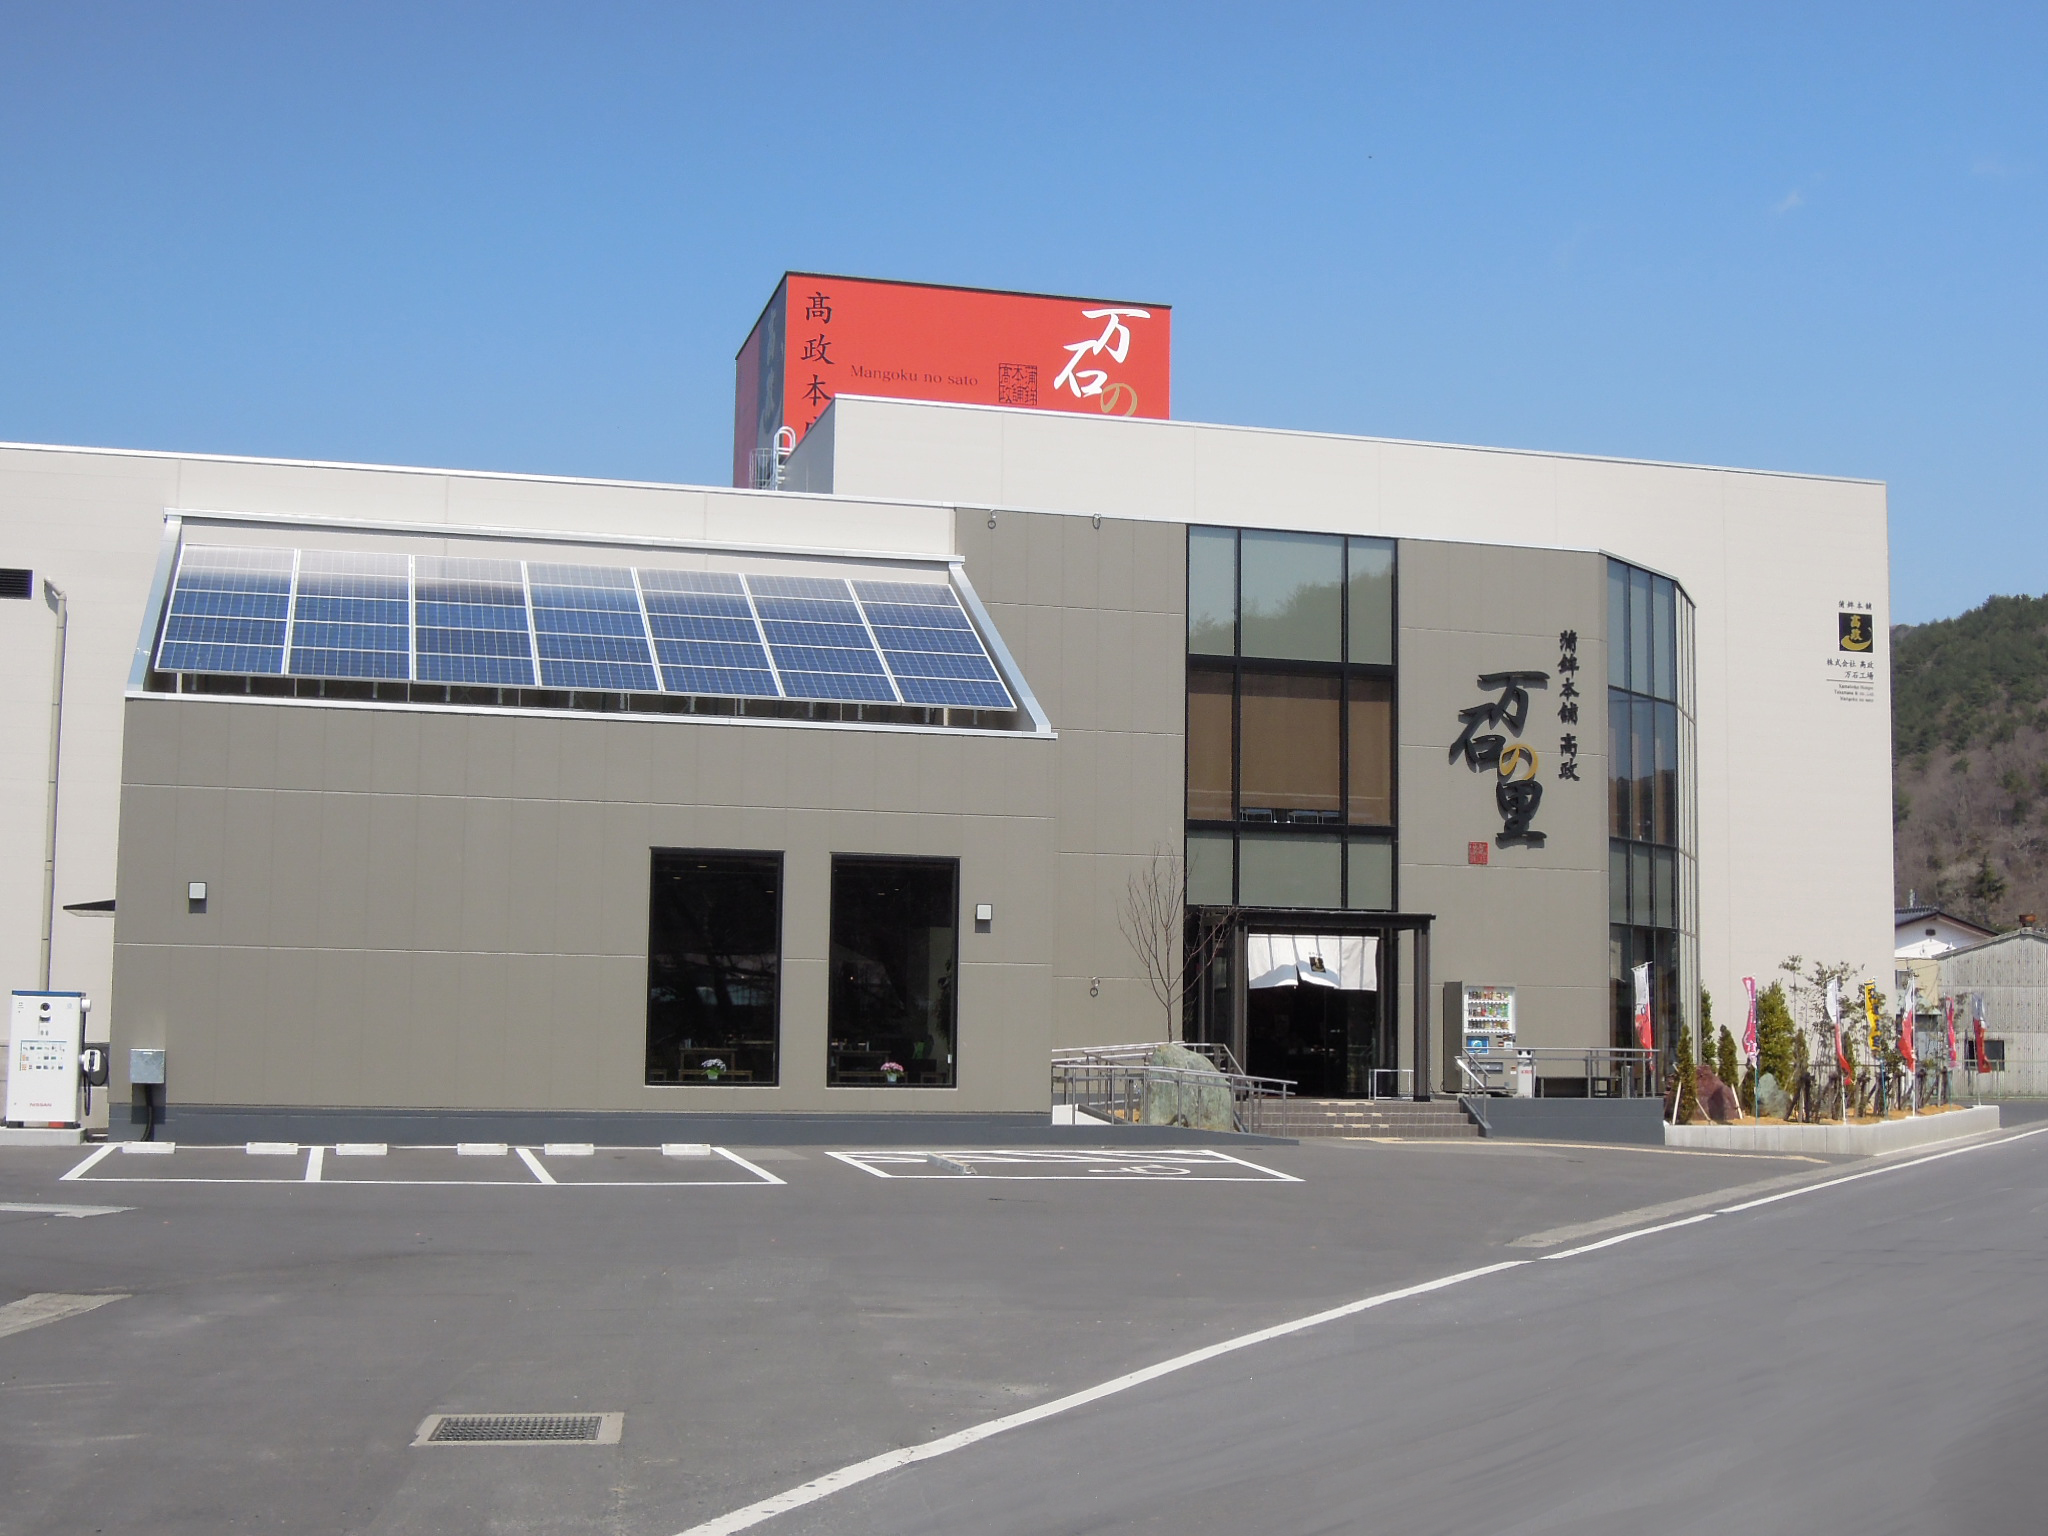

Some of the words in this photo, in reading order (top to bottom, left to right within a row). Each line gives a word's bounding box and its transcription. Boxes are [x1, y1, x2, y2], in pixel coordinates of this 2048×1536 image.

[850, 364, 918, 382] Mangoku
[923, 373, 943, 384] no
[947, 375, 979, 386] sato
[1449, 671, 1551, 848] 万石の里
